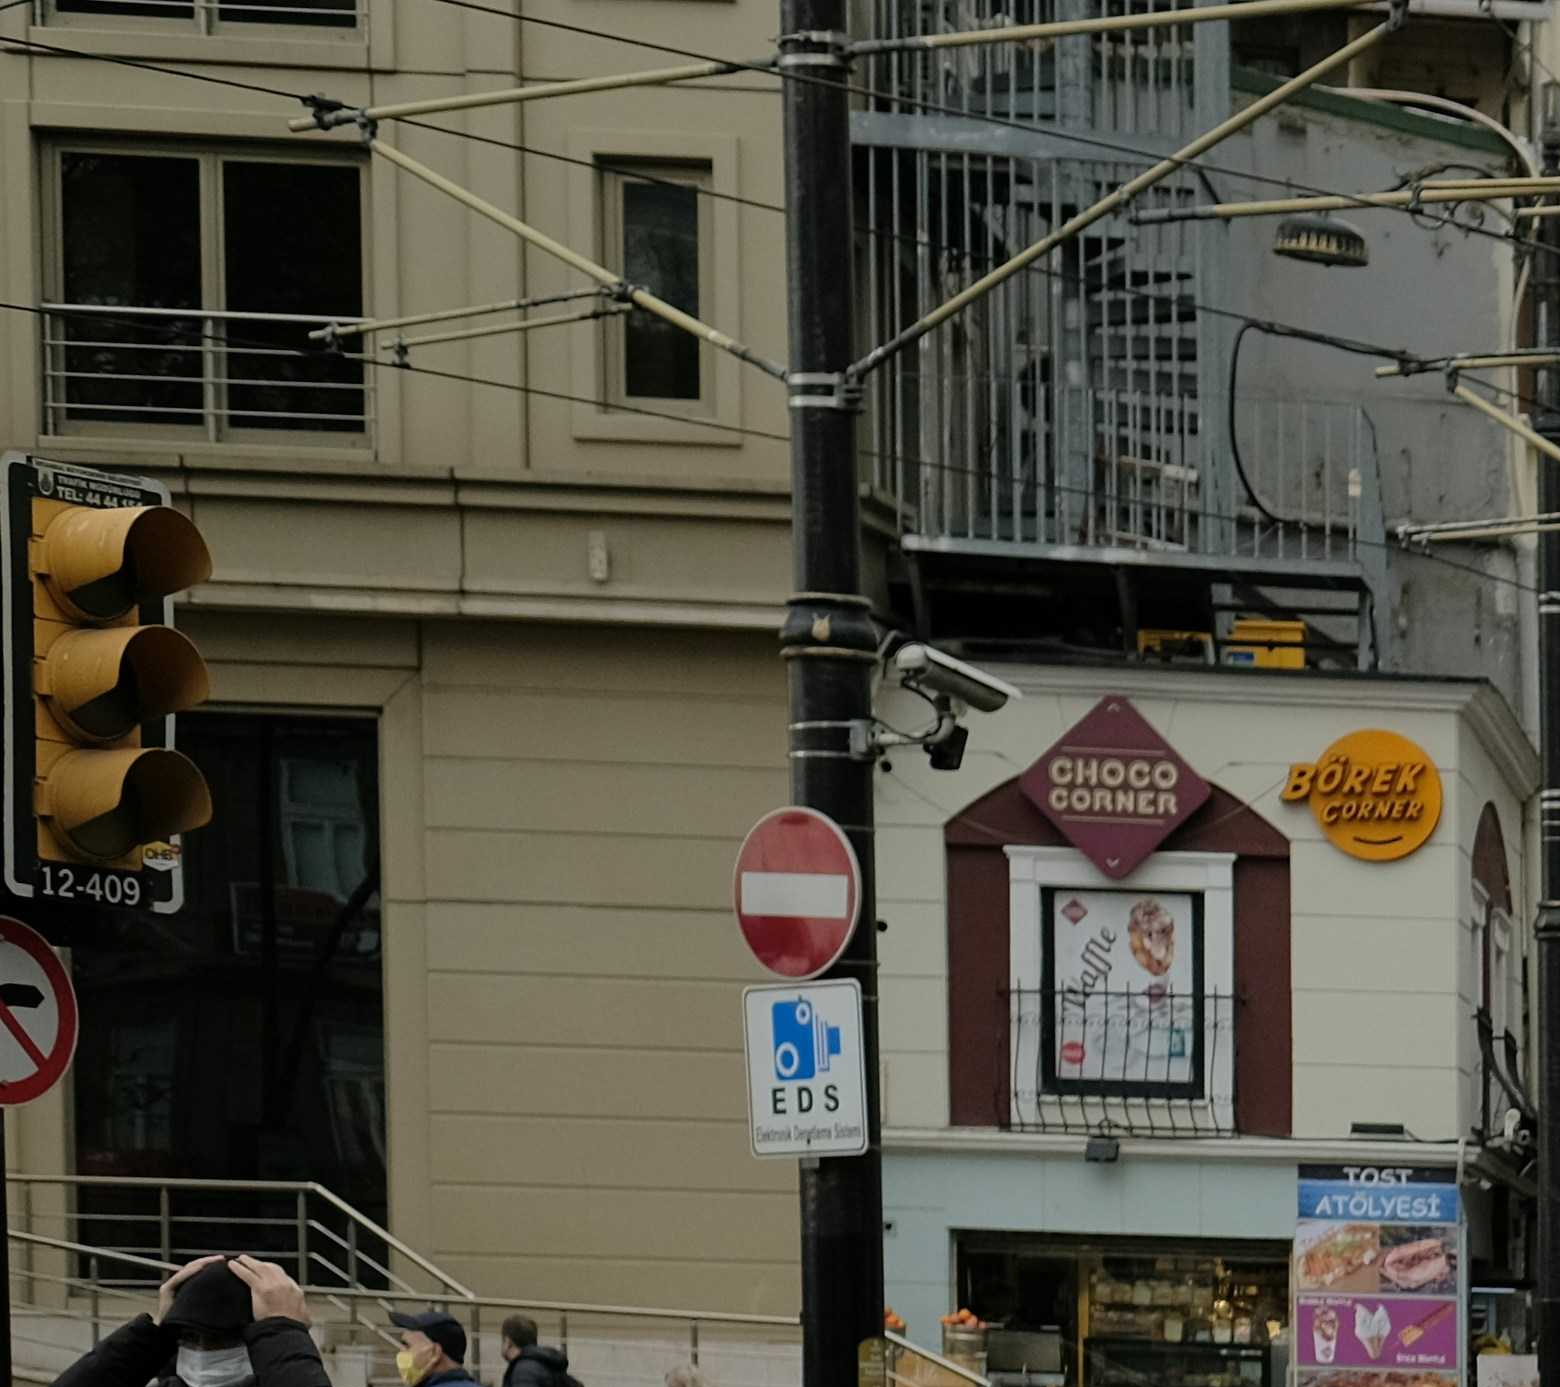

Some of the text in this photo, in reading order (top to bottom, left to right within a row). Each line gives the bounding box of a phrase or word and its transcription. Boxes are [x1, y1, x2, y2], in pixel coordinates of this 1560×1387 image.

[1048, 755, 1179, 790] CHOCO
[1280, 755, 1429, 804] BÖREK
[1048, 787, 1178, 815] CORNER
[1321, 798, 1425, 823] CORNER
[41, 866, 141, 906] 12-409
[771, 1084, 840, 1115] EDS
[1343, 1166, 1414, 1186] TOST
[1314, 1191, 1441, 1218] ATÖLYESİ
